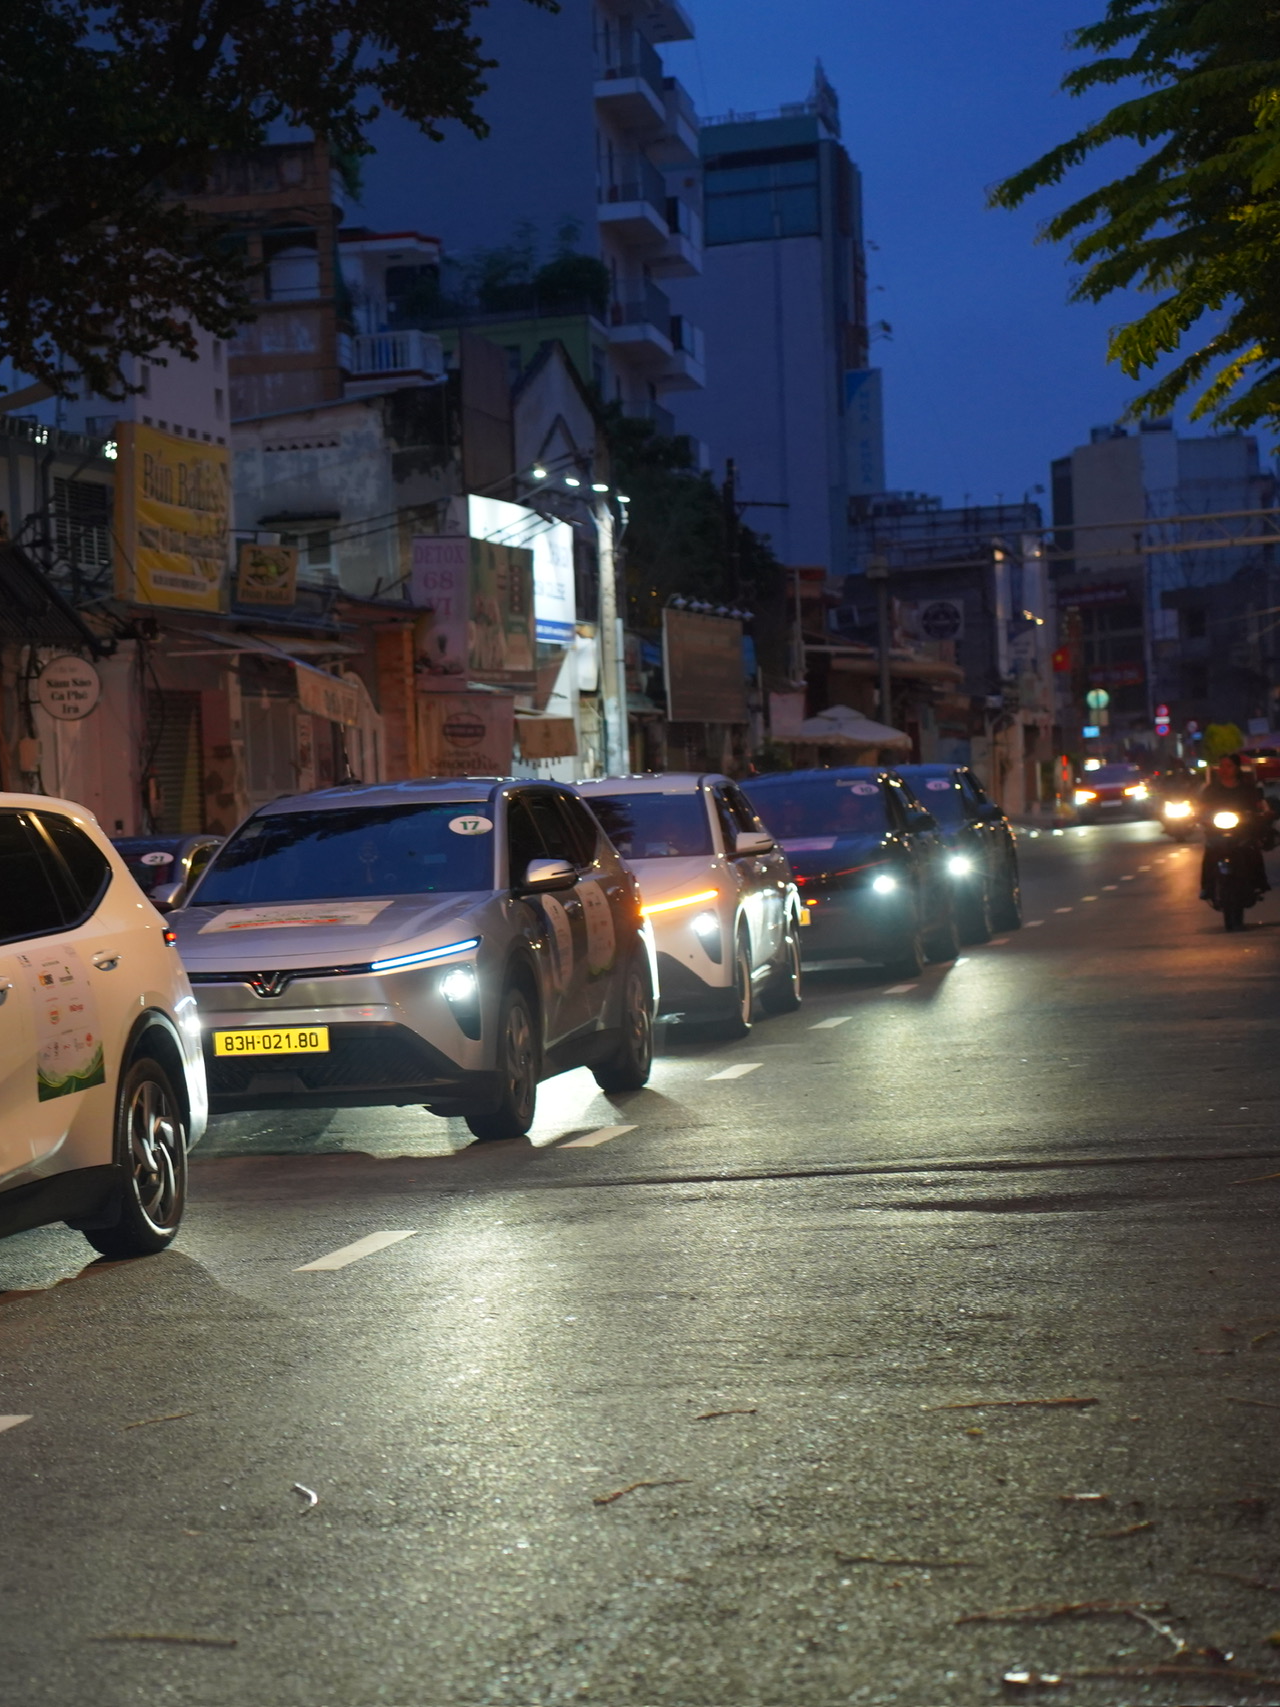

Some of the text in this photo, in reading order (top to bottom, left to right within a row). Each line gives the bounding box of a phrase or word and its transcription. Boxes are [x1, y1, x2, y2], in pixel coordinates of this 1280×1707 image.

[414, 546, 464, 564] DETOX
[423, 571, 454, 590] 68
[459, 820, 480, 830] 17
